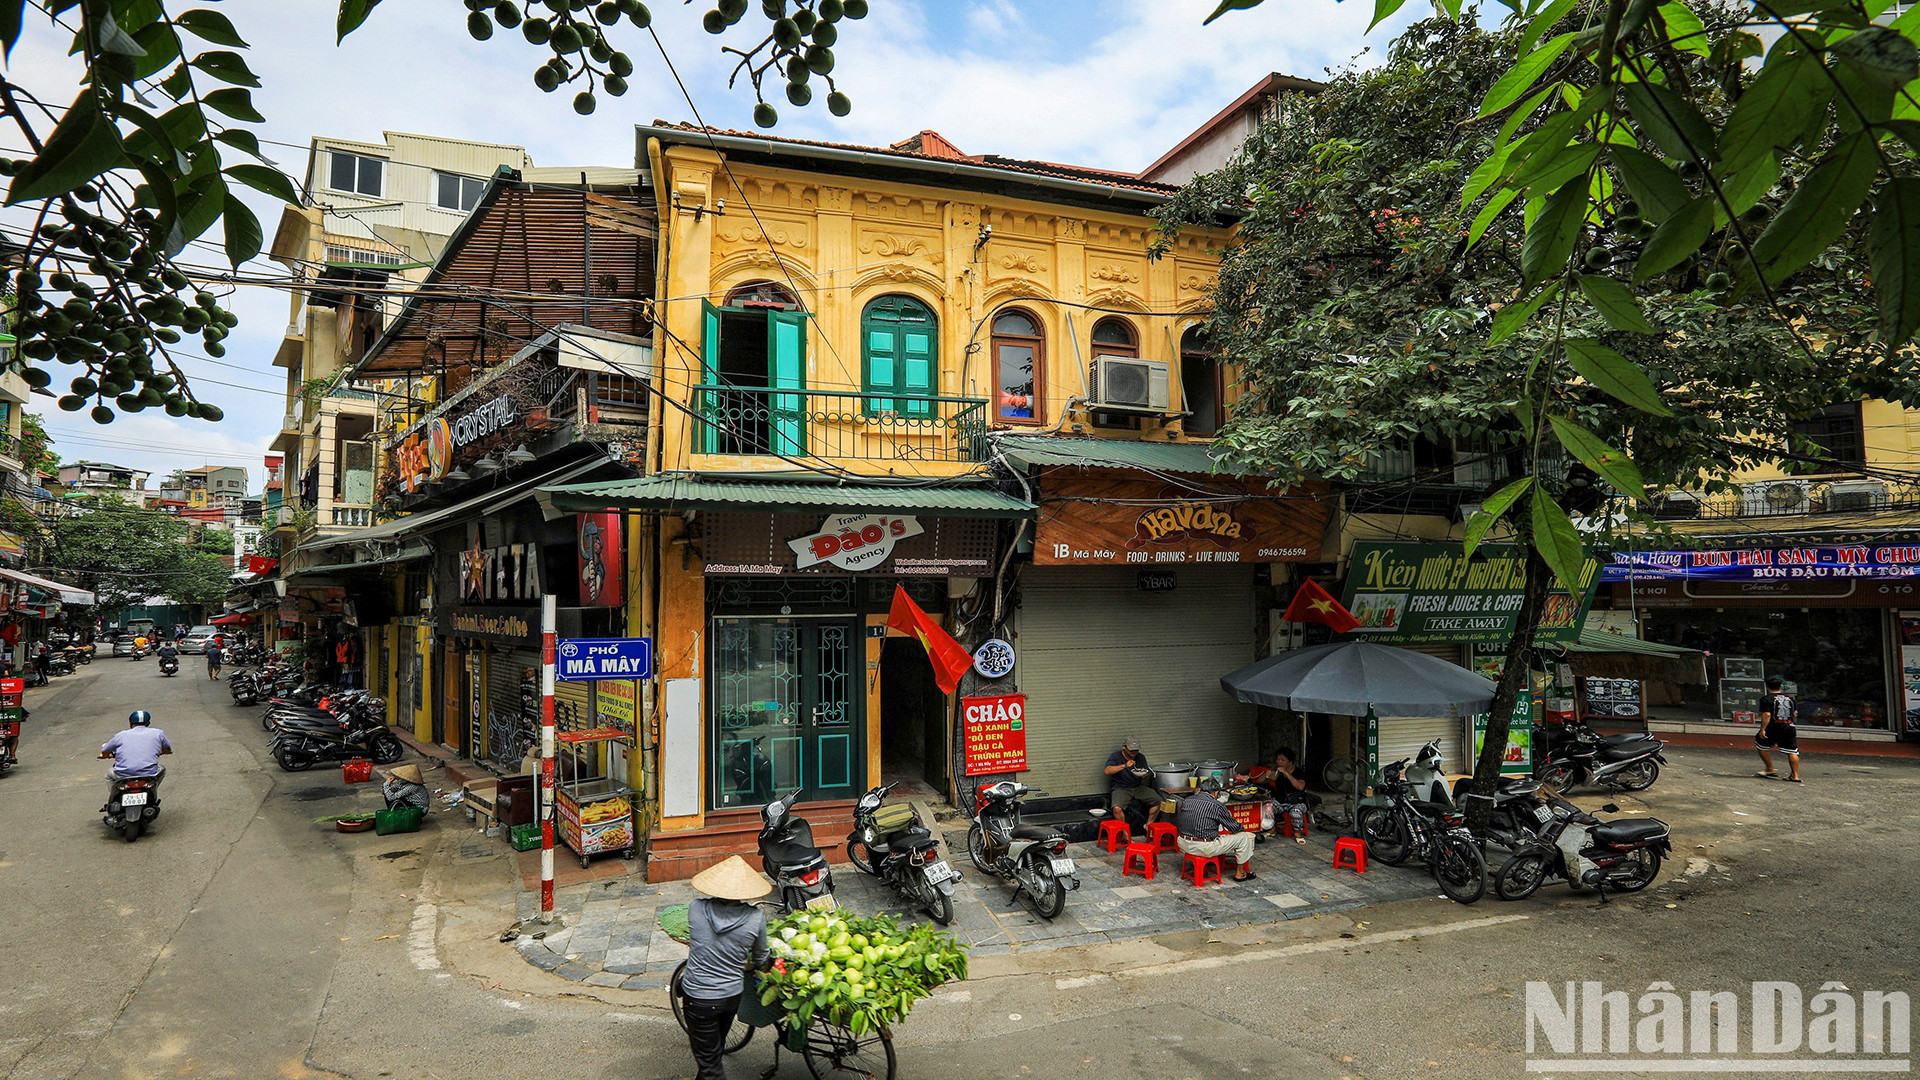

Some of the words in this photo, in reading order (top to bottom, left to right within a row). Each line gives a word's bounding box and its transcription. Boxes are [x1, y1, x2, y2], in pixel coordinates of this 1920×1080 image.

[845, 547, 885, 565] Agency
[1053, 544, 1070, 558] 1B
[1126, 552, 1148, 562] FOOD
[1155, 552, 1186, 562] DRINKS
[1196, 552, 1213, 562] LIVE
[1214, 552, 1240, 562] MUSIC
[1258, 548, 1307, 556] 0946756594
[1692, 549, 1732, 566] BÚN
[1753, 566, 1787, 578] BÚN
[1791, 566, 1828, 578] ĐẬU
[1832, 563, 1872, 577] MẮM
[1877, 564, 1915, 576] TÔM
[1409, 596, 1448, 612] FRESH
[1448, 595, 1482, 612] JUICE
[1482, 595, 1492, 612] &
[1430, 618, 1463, 629] TAKE
[1465, 618, 1505, 629] AWAY
[588, 644, 619, 654] PHỐ
[566, 656, 596, 674] MÃ
[602, 656, 640, 672] MÂY
[966, 699, 1022, 723] CHÁO
[986, 724, 1009, 732] XANH
